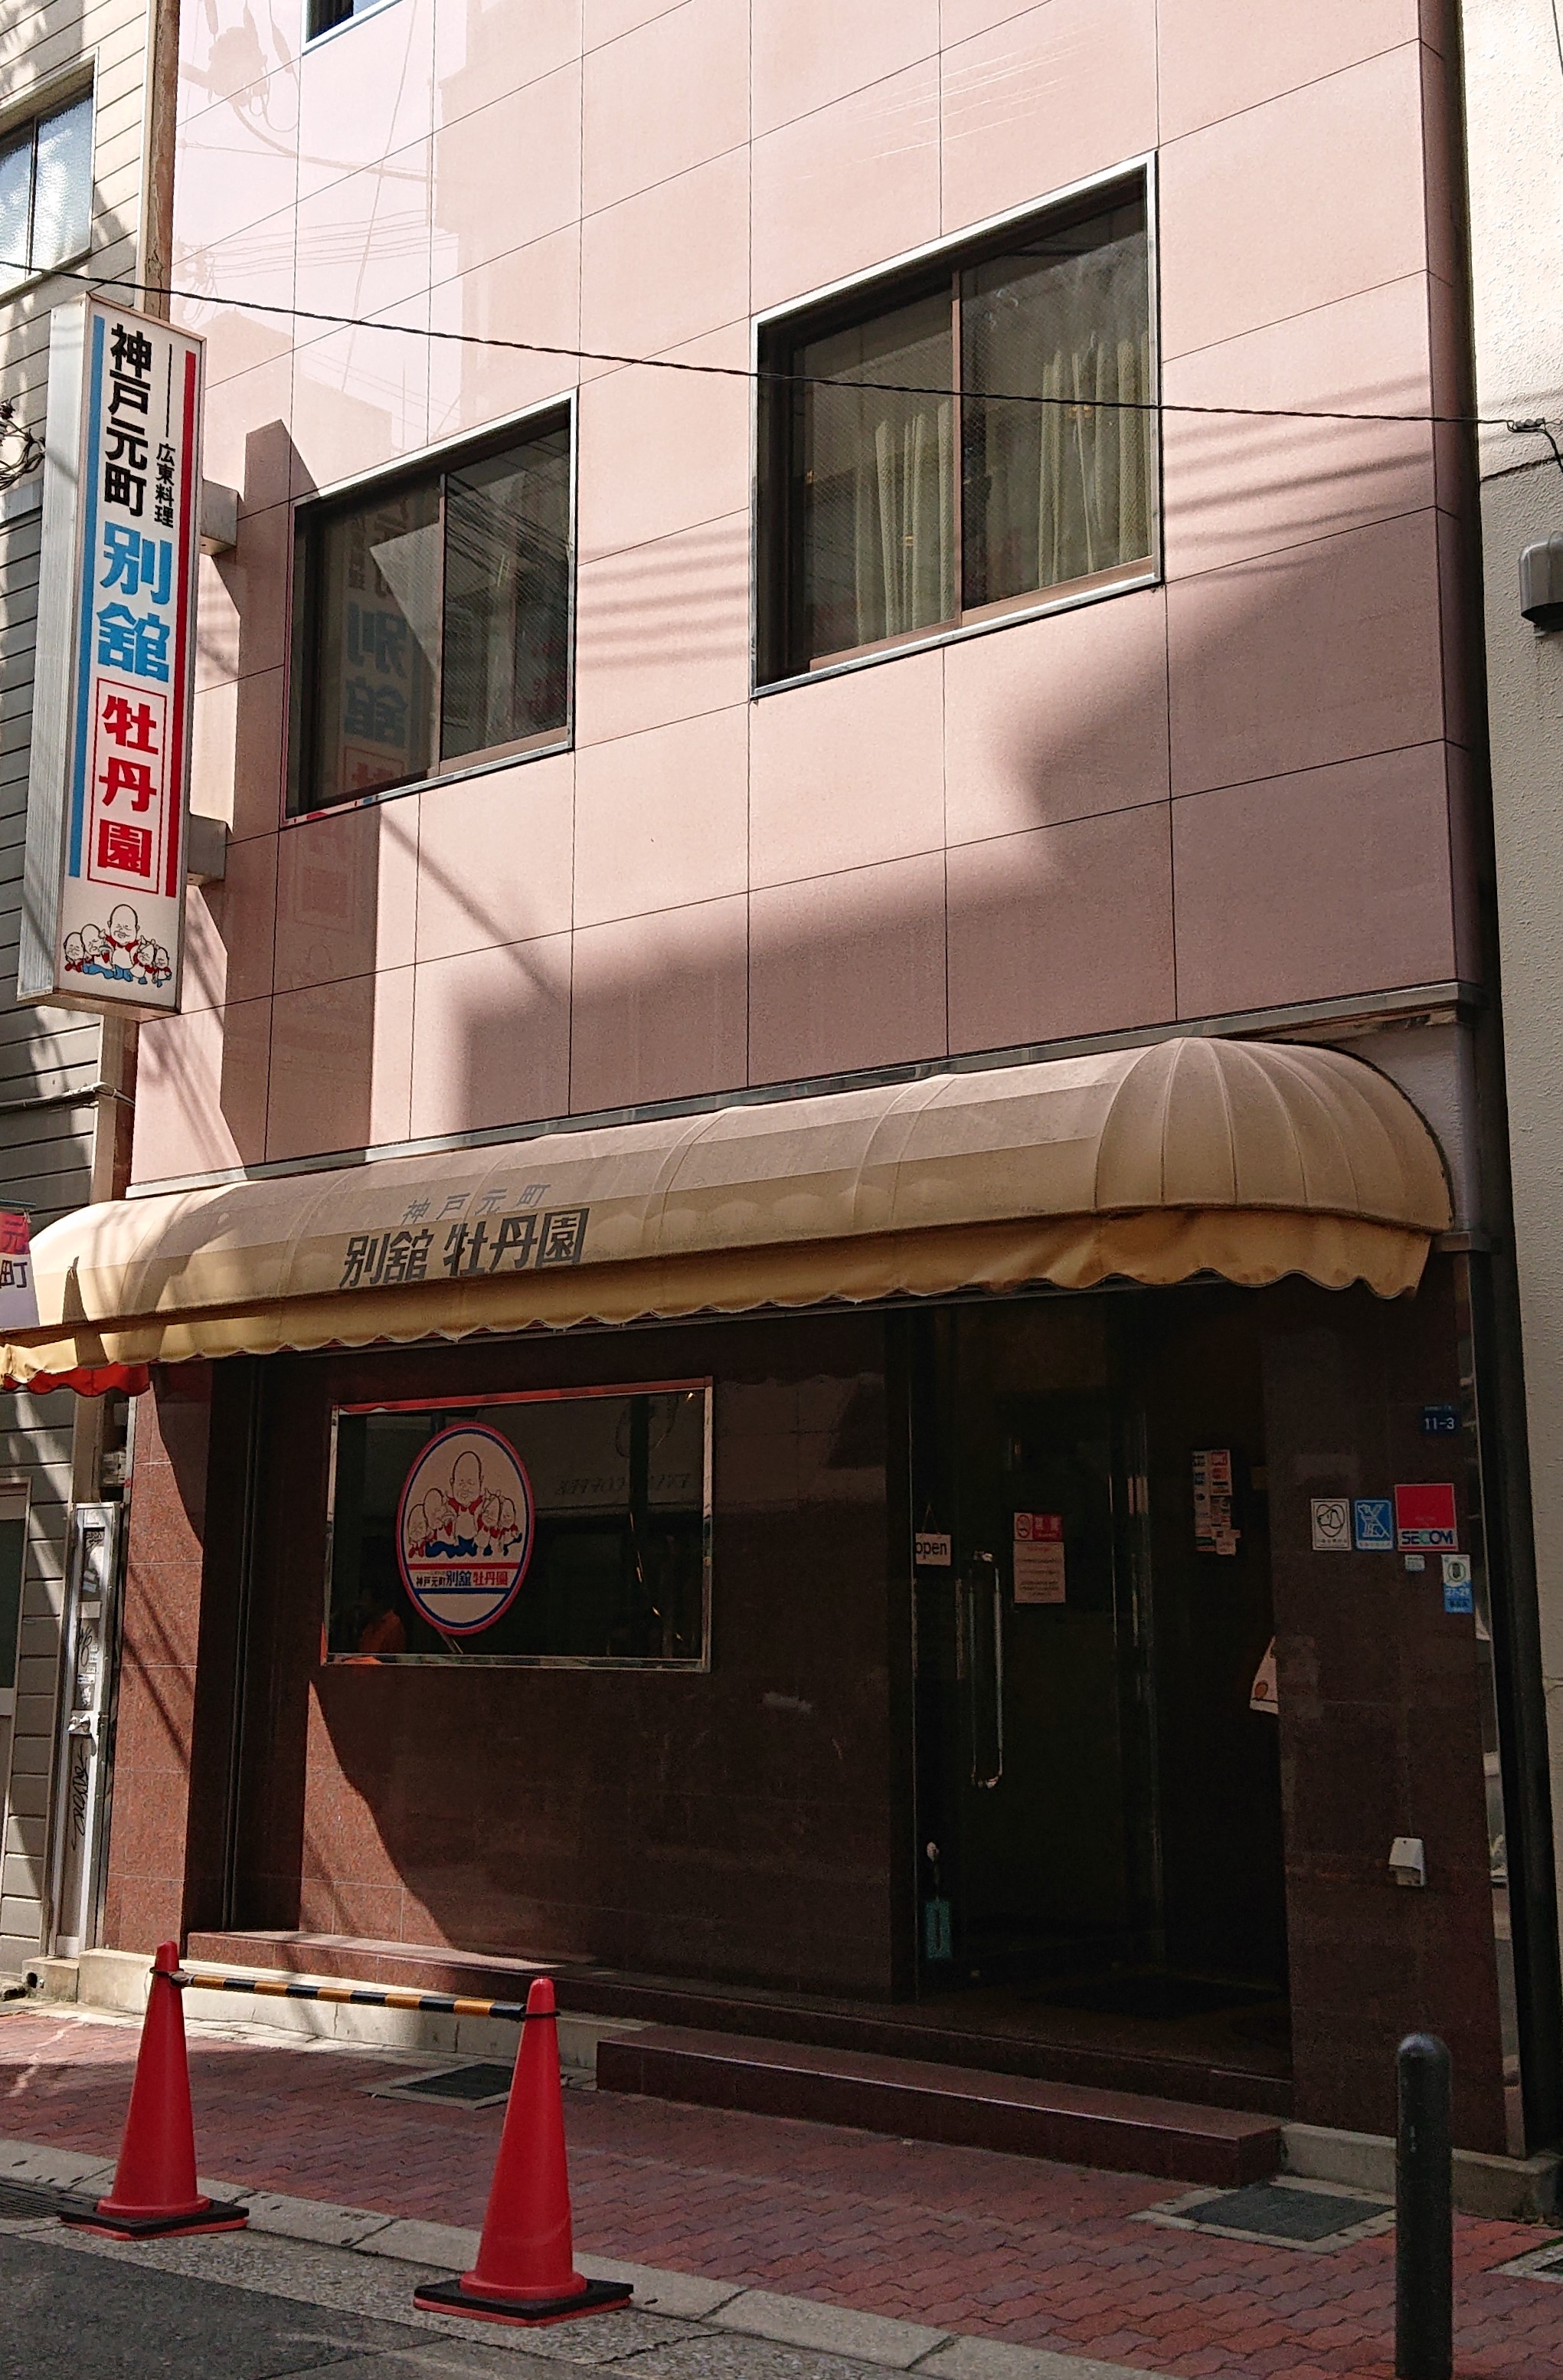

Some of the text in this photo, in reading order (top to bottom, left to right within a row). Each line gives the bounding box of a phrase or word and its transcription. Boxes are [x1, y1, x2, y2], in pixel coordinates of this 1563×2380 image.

[103, 322, 152, 518] 神戸元町
[154, 443, 176, 529] 広東料理
[97, 694, 159, 879] 牡丹園
[401, 1183, 551, 1225] 神戸元町
[443, 1207, 590, 1278] 牡丹園
[1424, 1416, 1455, 1430] 11-3
[914, 1542, 947, 1560] open
[1401, 1530, 1453, 1545] SECOM
[416, 1575, 446, 1587] 神戸元町
[473, 1570, 508, 1586] 牡丹園
